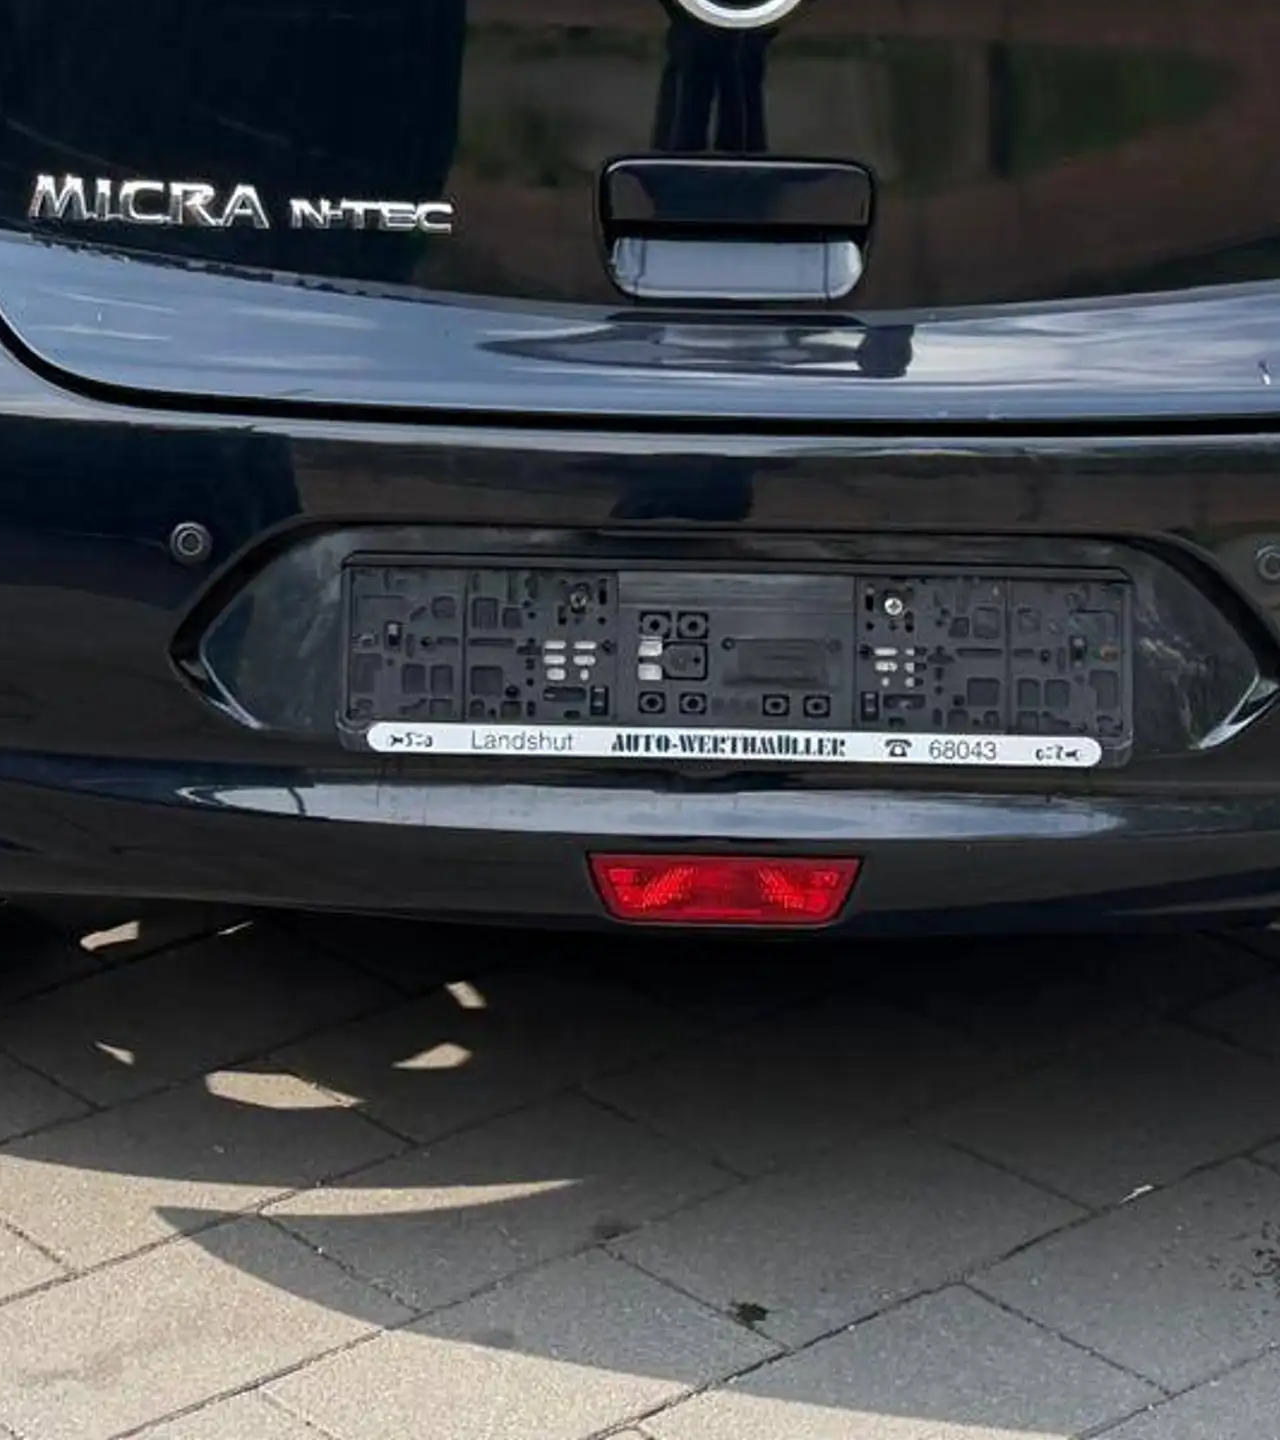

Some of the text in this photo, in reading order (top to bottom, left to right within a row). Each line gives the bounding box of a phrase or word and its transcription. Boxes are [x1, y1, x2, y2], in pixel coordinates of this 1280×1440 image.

[28, 173, 270, 228] MICRA
[470, 729, 998, 760] Landshut AUTO-WERTHMÜLLER 68043
